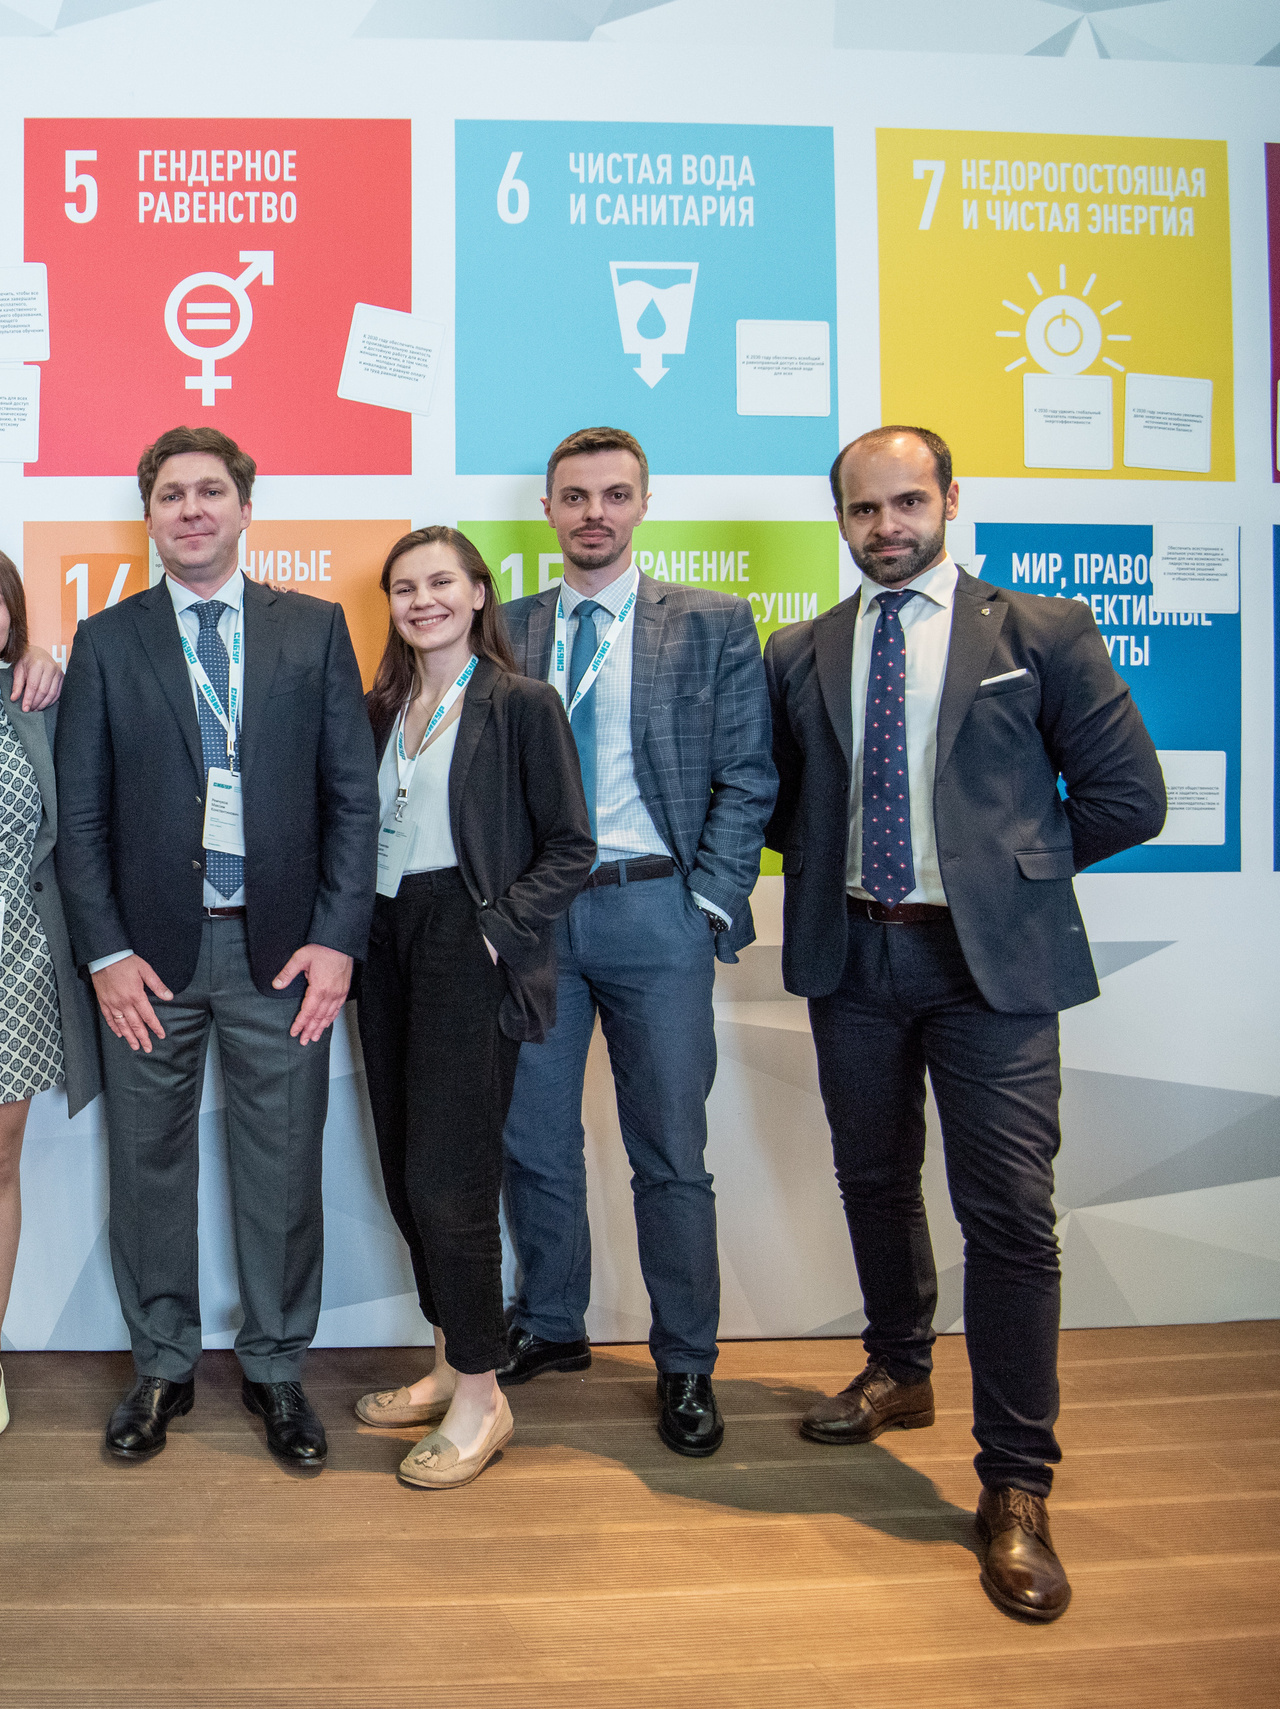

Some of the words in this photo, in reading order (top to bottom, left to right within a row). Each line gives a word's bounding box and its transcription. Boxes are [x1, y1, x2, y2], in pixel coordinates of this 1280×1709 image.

[64, 149, 99, 224] 5
[138, 149, 297, 187] ГЕНДЕРНОЕ
[569, 152, 673, 185] ЧИСТАЯ
[681, 153, 756, 192] ВОДА
[961, 158, 1207, 202] НЕДОРОГОСТОЯЩАЯ
[496, 151, 530, 225] 6
[912, 159, 946, 231] 7
[138, 191, 297, 224] РАВЕНСТВО
[569, 193, 586, 225] И
[595, 193, 755, 227] САНИТАРИЯ
[962, 198, 979, 230] И
[985, 199, 1080, 233] ЧИСТАЯ
[1086, 202, 1195, 237] ЭНЕРГИЯ
[1011, 552, 1067, 589] МИР,
[556, 640, 565, 672] СИБУР
[591, 640, 611, 672] СИБУР
